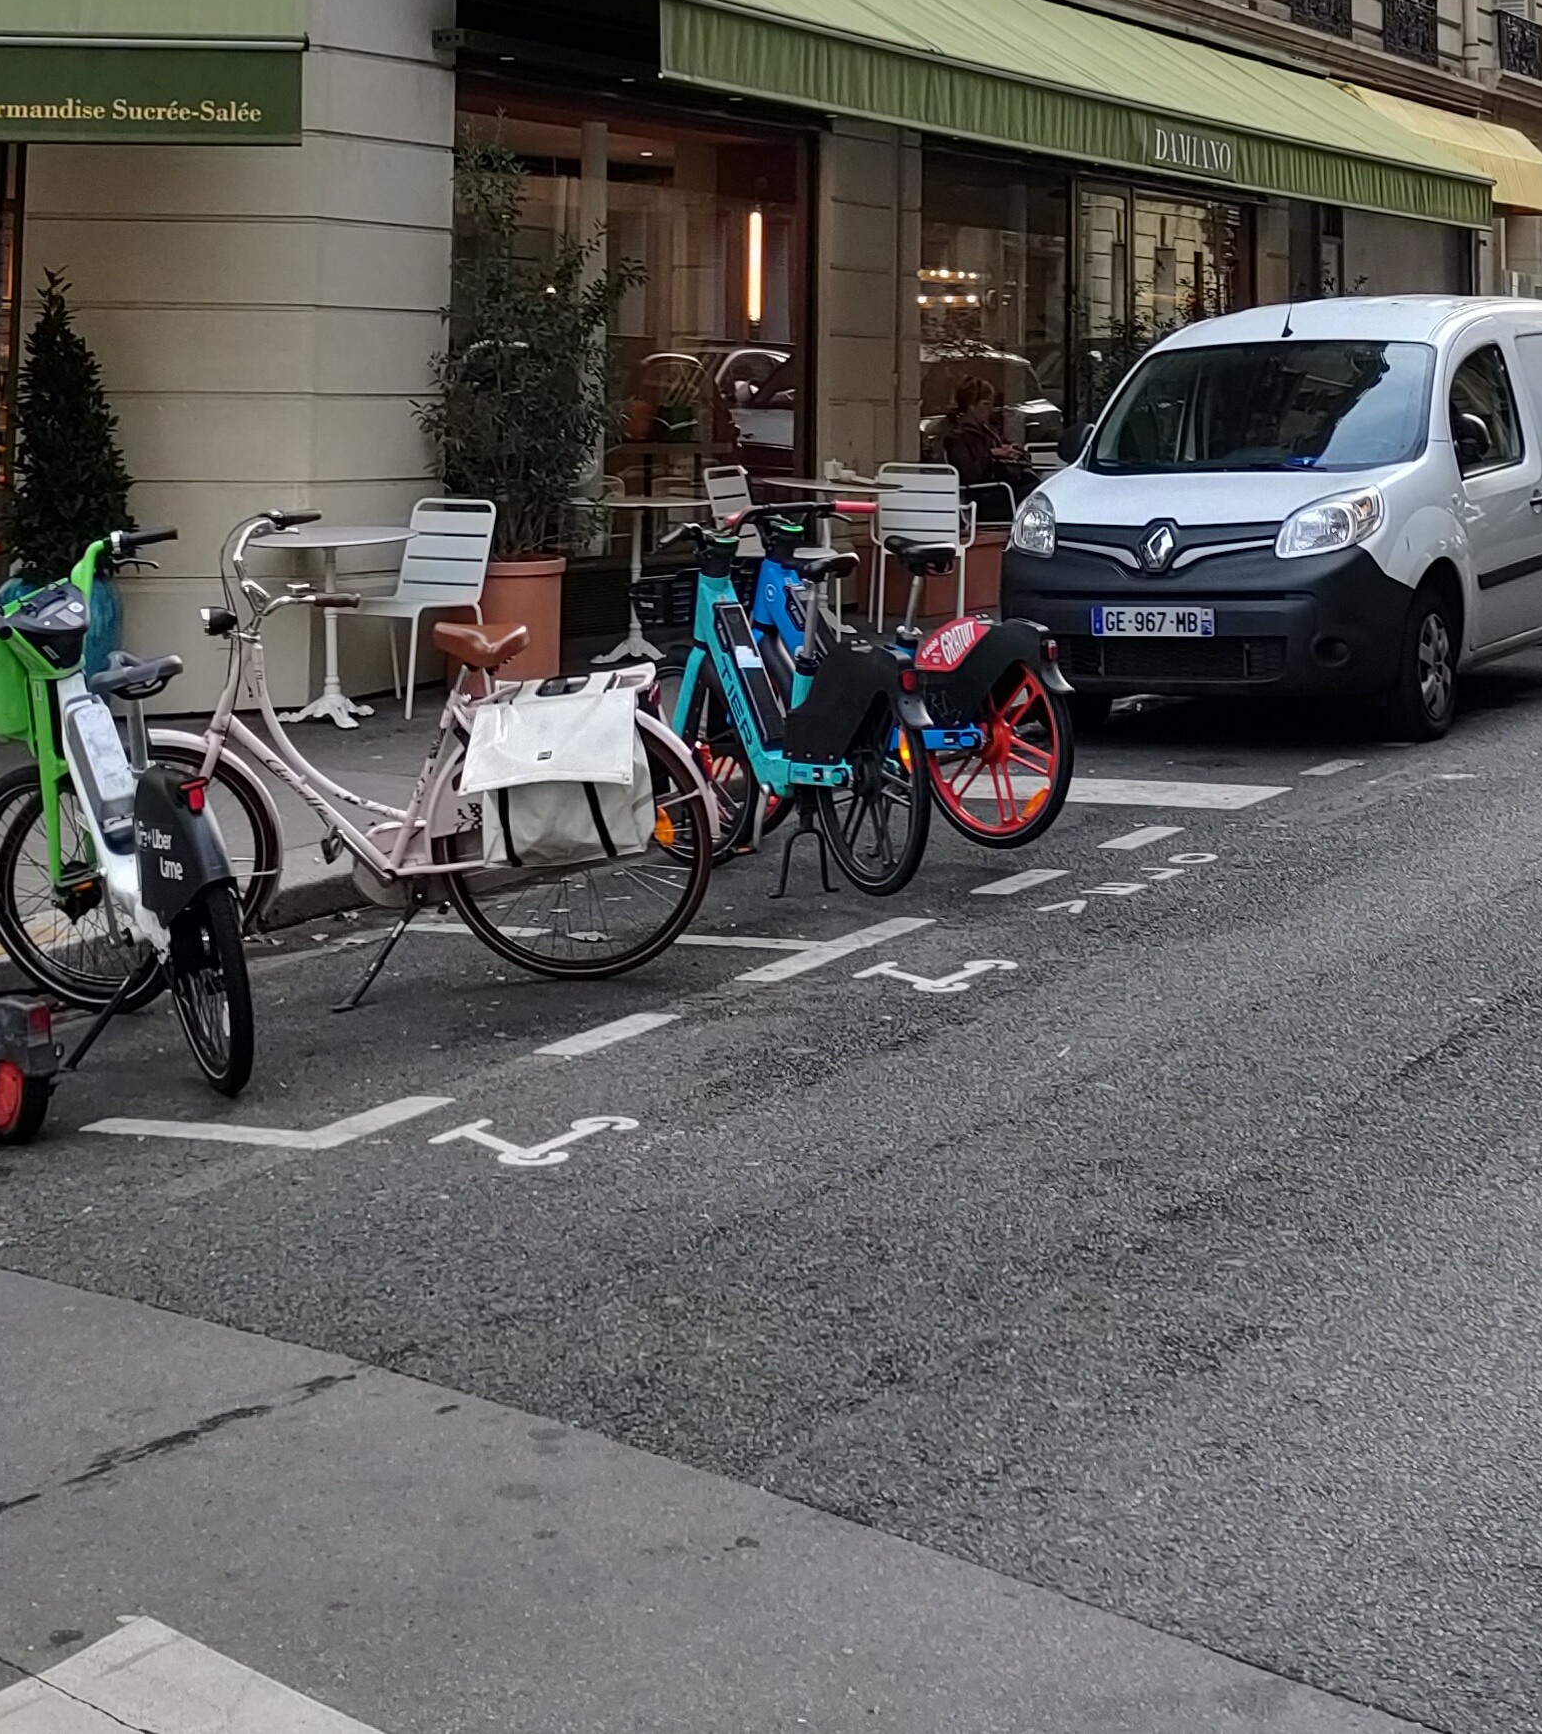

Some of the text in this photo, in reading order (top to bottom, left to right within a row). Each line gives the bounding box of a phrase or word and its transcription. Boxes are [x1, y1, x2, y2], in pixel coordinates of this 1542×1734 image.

[112, 98, 262, 123] Sucrée-Salée
[1155, 128, 1231, 173] DAMIANO
[940, 621, 975, 665] GRATUIT
[721, 655, 753, 745] TIER
[151, 828, 172, 850] Uber
[159, 856, 184, 881] Lime
